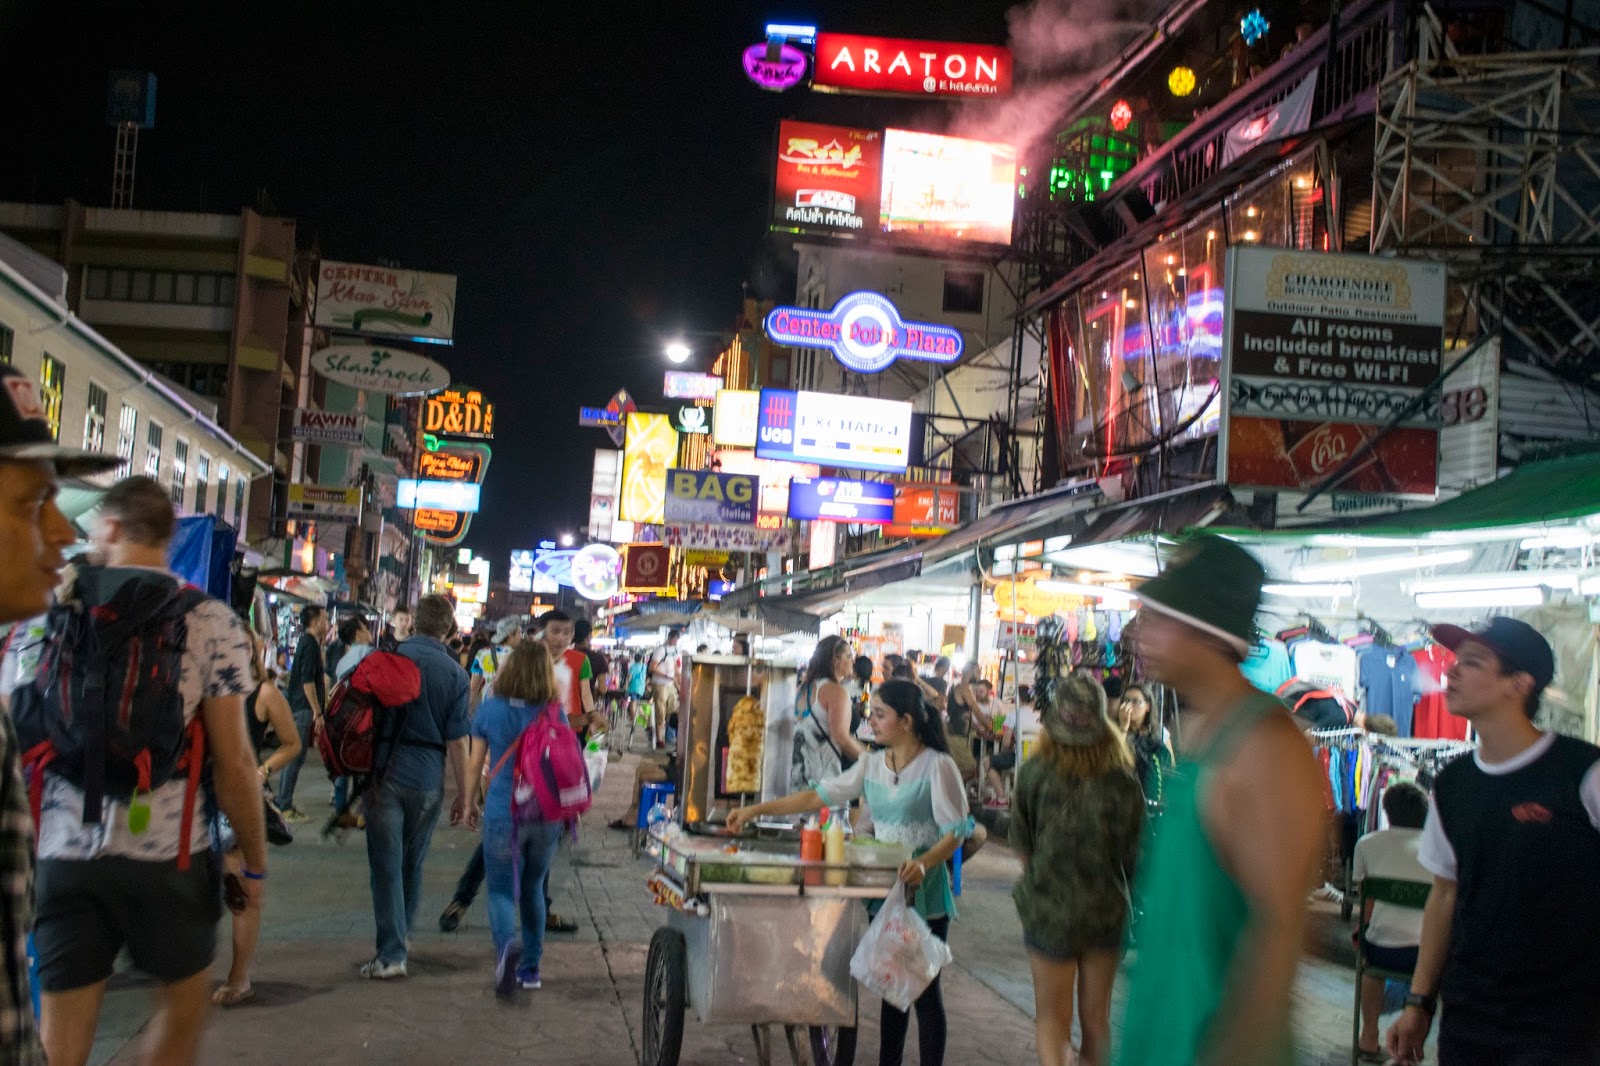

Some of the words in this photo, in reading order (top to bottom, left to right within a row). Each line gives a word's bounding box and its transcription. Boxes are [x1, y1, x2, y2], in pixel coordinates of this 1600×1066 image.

[831, 46, 998, 81] ARATON
[322, 265, 398, 288] CENTER
[1285, 272, 1393, 292] CHAROENDEE
[320, 281, 376, 303] Khao
[1284, 285, 1343, 299] BOUTIQUE
[1348, 290, 1392, 304] HOSTEL
[1267, 300, 1315, 314] Outdoor
[1320, 304, 1350, 316] Patio
[1355, 308, 1418, 322] Restaurant
[775, 312, 842, 340] Center
[849, 321, 899, 347] Point
[905, 327, 956, 354] Plaza
[1291, 318, 1319, 336] All
[1327, 323, 1393, 342] rooms
[1340, 344, 1439, 366] breakfast
[325, 354, 433, 383] Shamrock
[1273, 356, 1290, 374] &
[1298, 358, 1347, 379] Free
[300, 411, 357, 428] KAWIN
[425, 399, 482, 433] D&D
[761, 426, 793, 444] UOB
[673, 472, 753, 503] BAG
[918, 496, 954, 507] EXCANGE
[720, 506, 751, 521] Station
[925, 506, 955, 522] ATM
